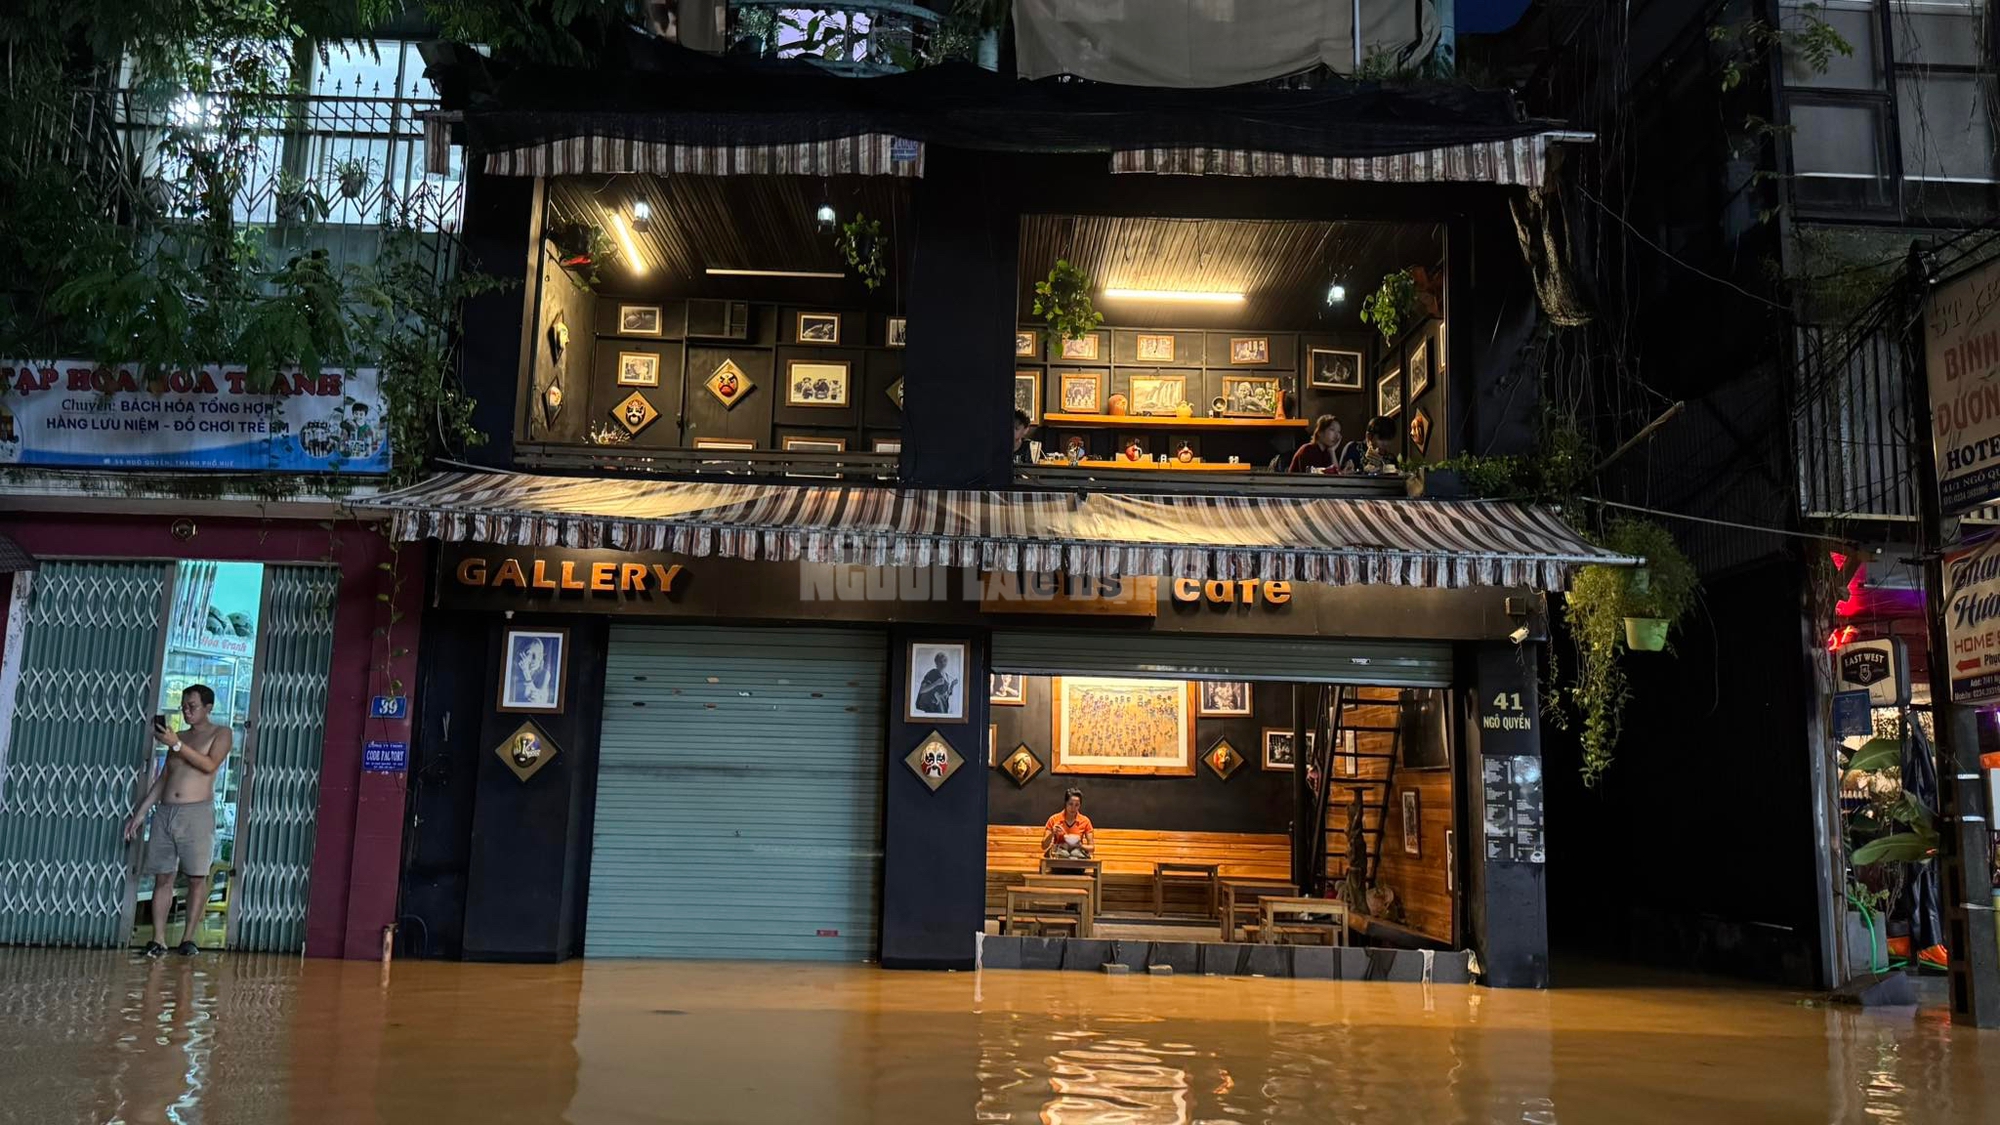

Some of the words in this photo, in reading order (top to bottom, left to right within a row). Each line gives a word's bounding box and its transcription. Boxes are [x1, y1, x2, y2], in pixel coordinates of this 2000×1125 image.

[121, 398, 160, 413] BÁCH
[165, 399, 195, 413] HÓA
[199, 397, 239, 414] TỔNG
[47, 415, 87, 430] HÀNG
[91, 418, 120, 431] LƯU
[124, 417, 159, 434] NIỆM
[199, 420, 233, 432] CHƠI
[238, 418, 265, 433] TRẺ
[456, 557, 684, 593] GALLERY
[1954, 632, 1994, 654] HOME
[1844, 654, 1862, 668] EAST
[1863, 653, 1885, 665] WEST
[1493, 692, 1523, 711] 41
[1483, 713, 1501, 729] NGÔ
